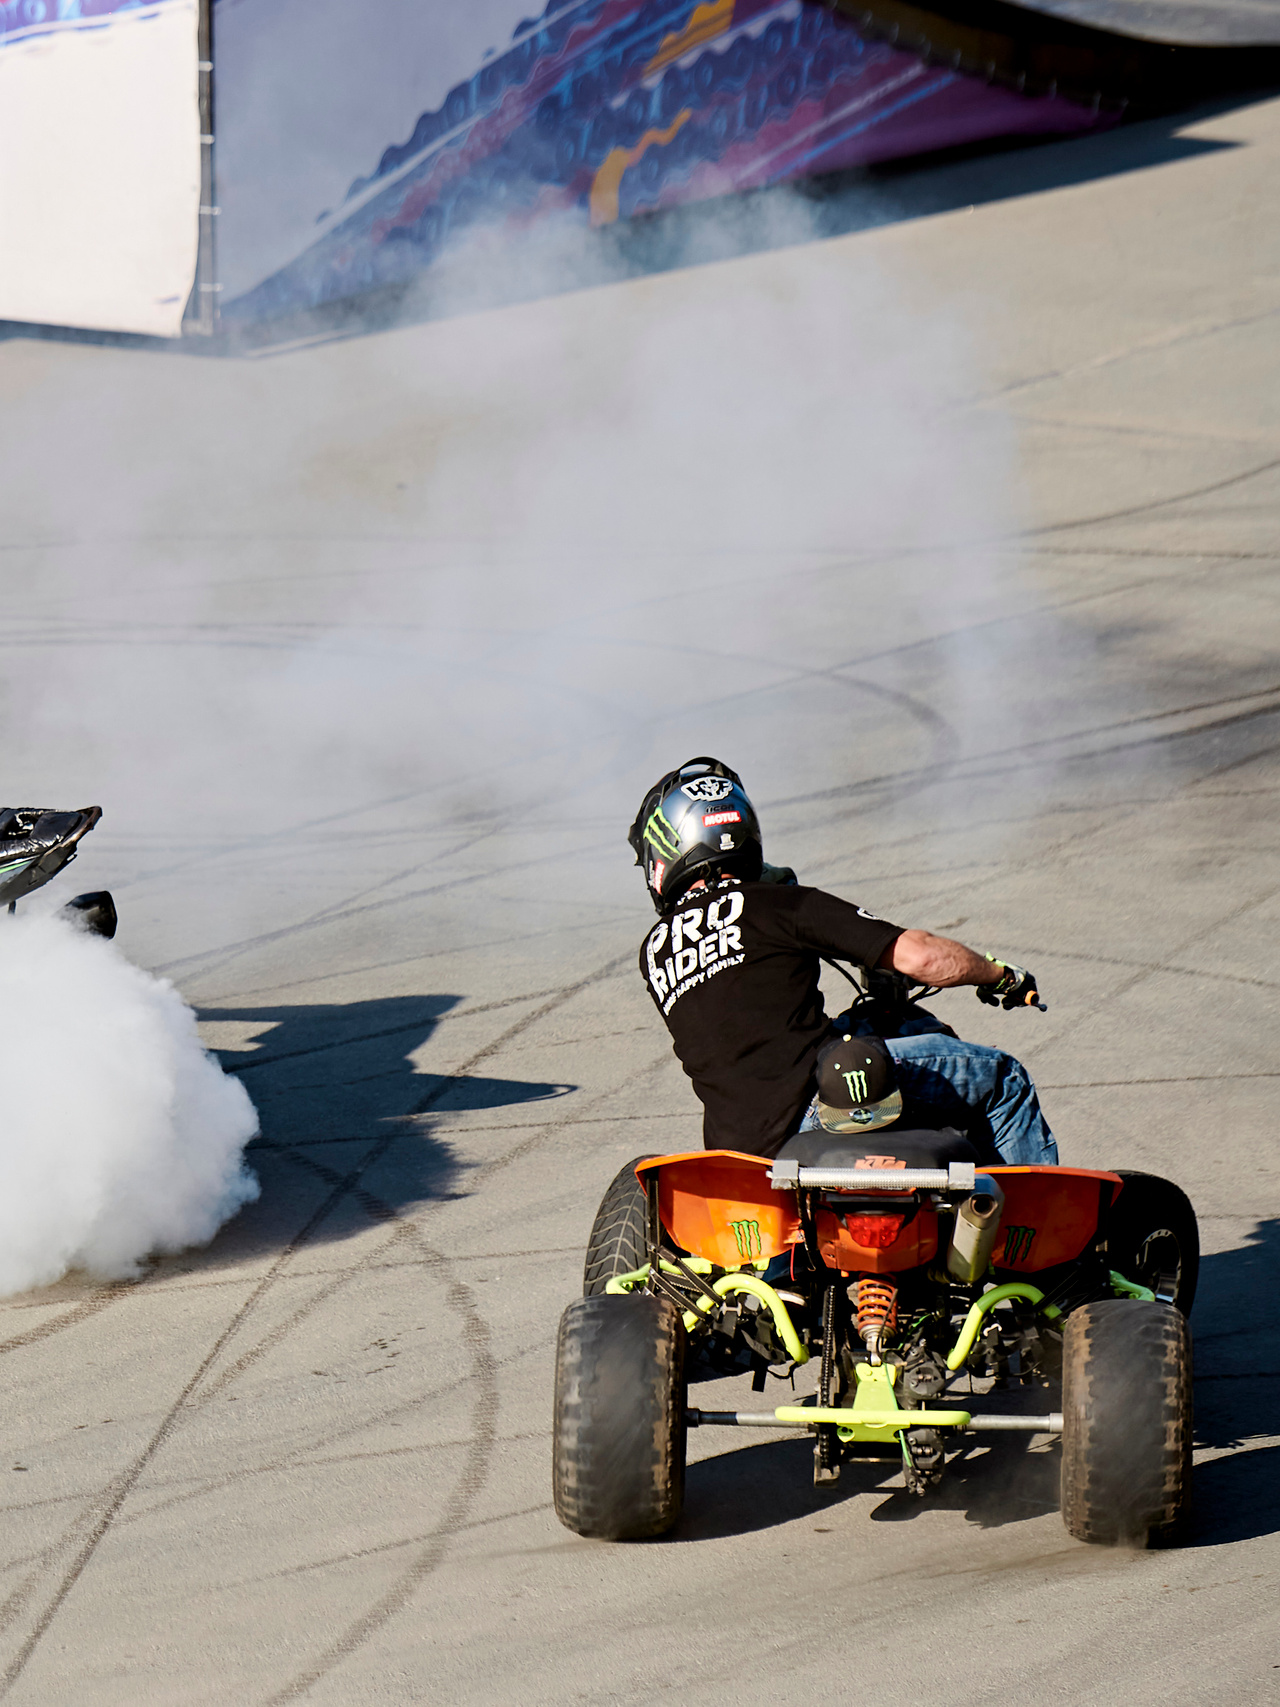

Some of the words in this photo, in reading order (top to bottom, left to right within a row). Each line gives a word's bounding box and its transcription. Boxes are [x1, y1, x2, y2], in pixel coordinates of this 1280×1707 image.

[703, 812, 740, 827] MOTUL
[646, 891, 745, 976] PRO
[649, 925, 744, 1004] RIDER
[706, 953, 746, 979] FAMILY
[854, 1155, 907, 1169] KTM
